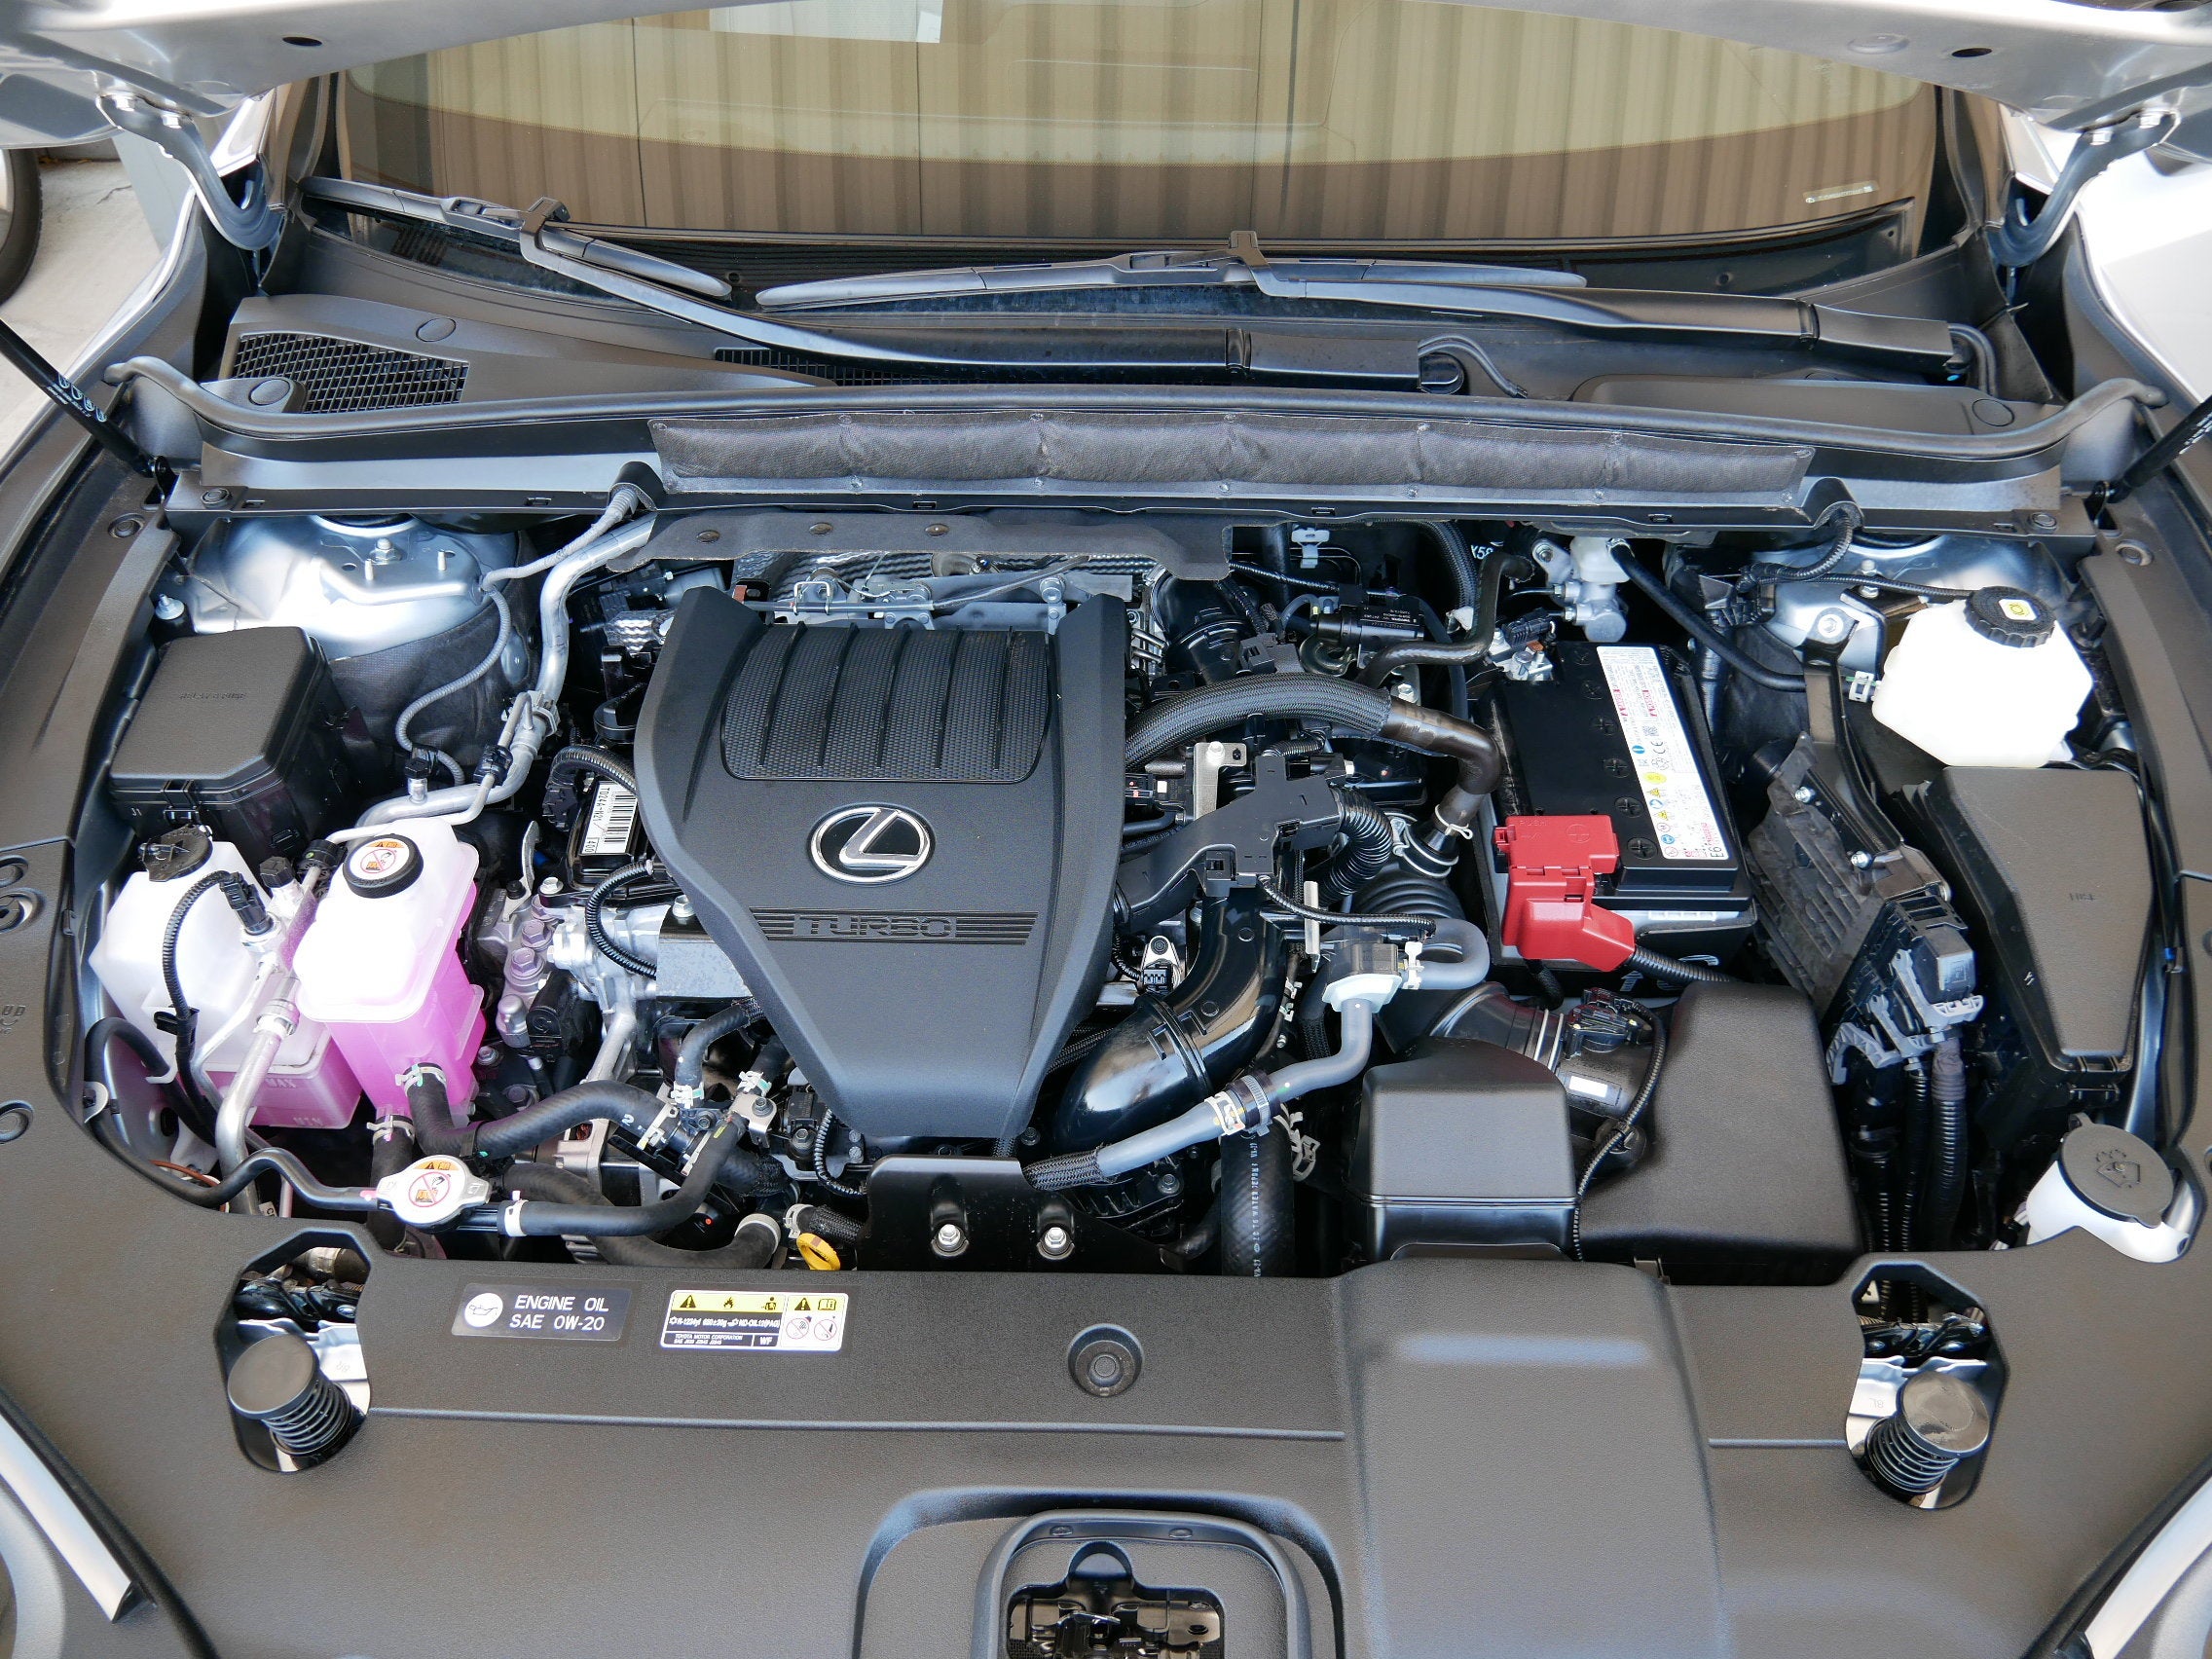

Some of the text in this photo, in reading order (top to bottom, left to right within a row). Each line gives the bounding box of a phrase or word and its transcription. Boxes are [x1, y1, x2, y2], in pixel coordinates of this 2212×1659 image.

[798, 913, 952, 938] TURBO
[514, 1294, 610, 1312] ENGINE OIL
[509, 1313, 606, 1332] SAE 0W-20
[759, 1335, 773, 1346] WF
